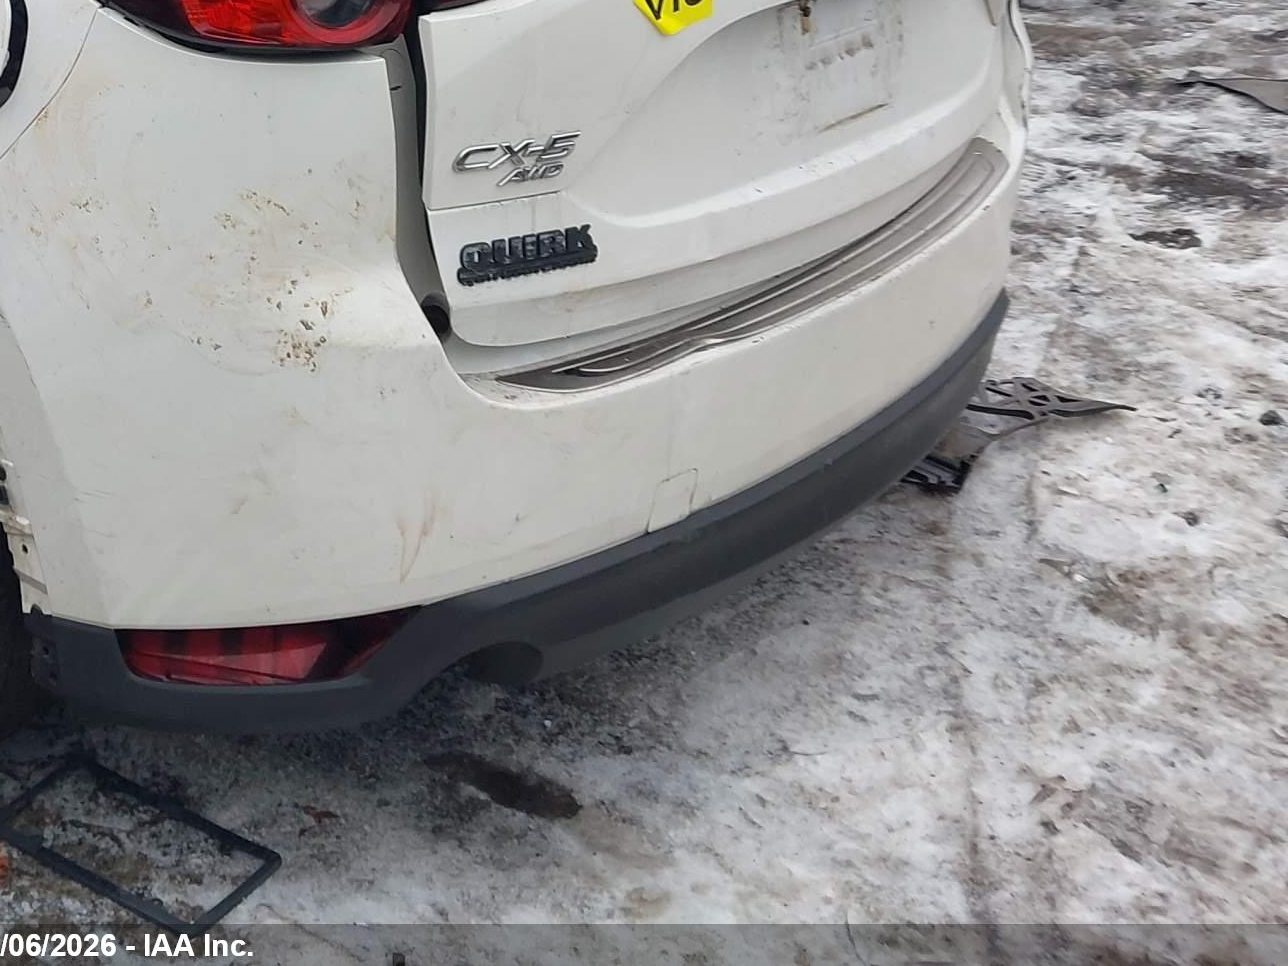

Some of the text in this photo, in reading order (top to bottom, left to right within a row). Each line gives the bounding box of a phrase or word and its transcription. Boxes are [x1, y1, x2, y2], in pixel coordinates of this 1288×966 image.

[452, 131, 581, 172] CX-5
[497, 161, 564, 186] AWD
[460, 224, 593, 274] QUIRK
